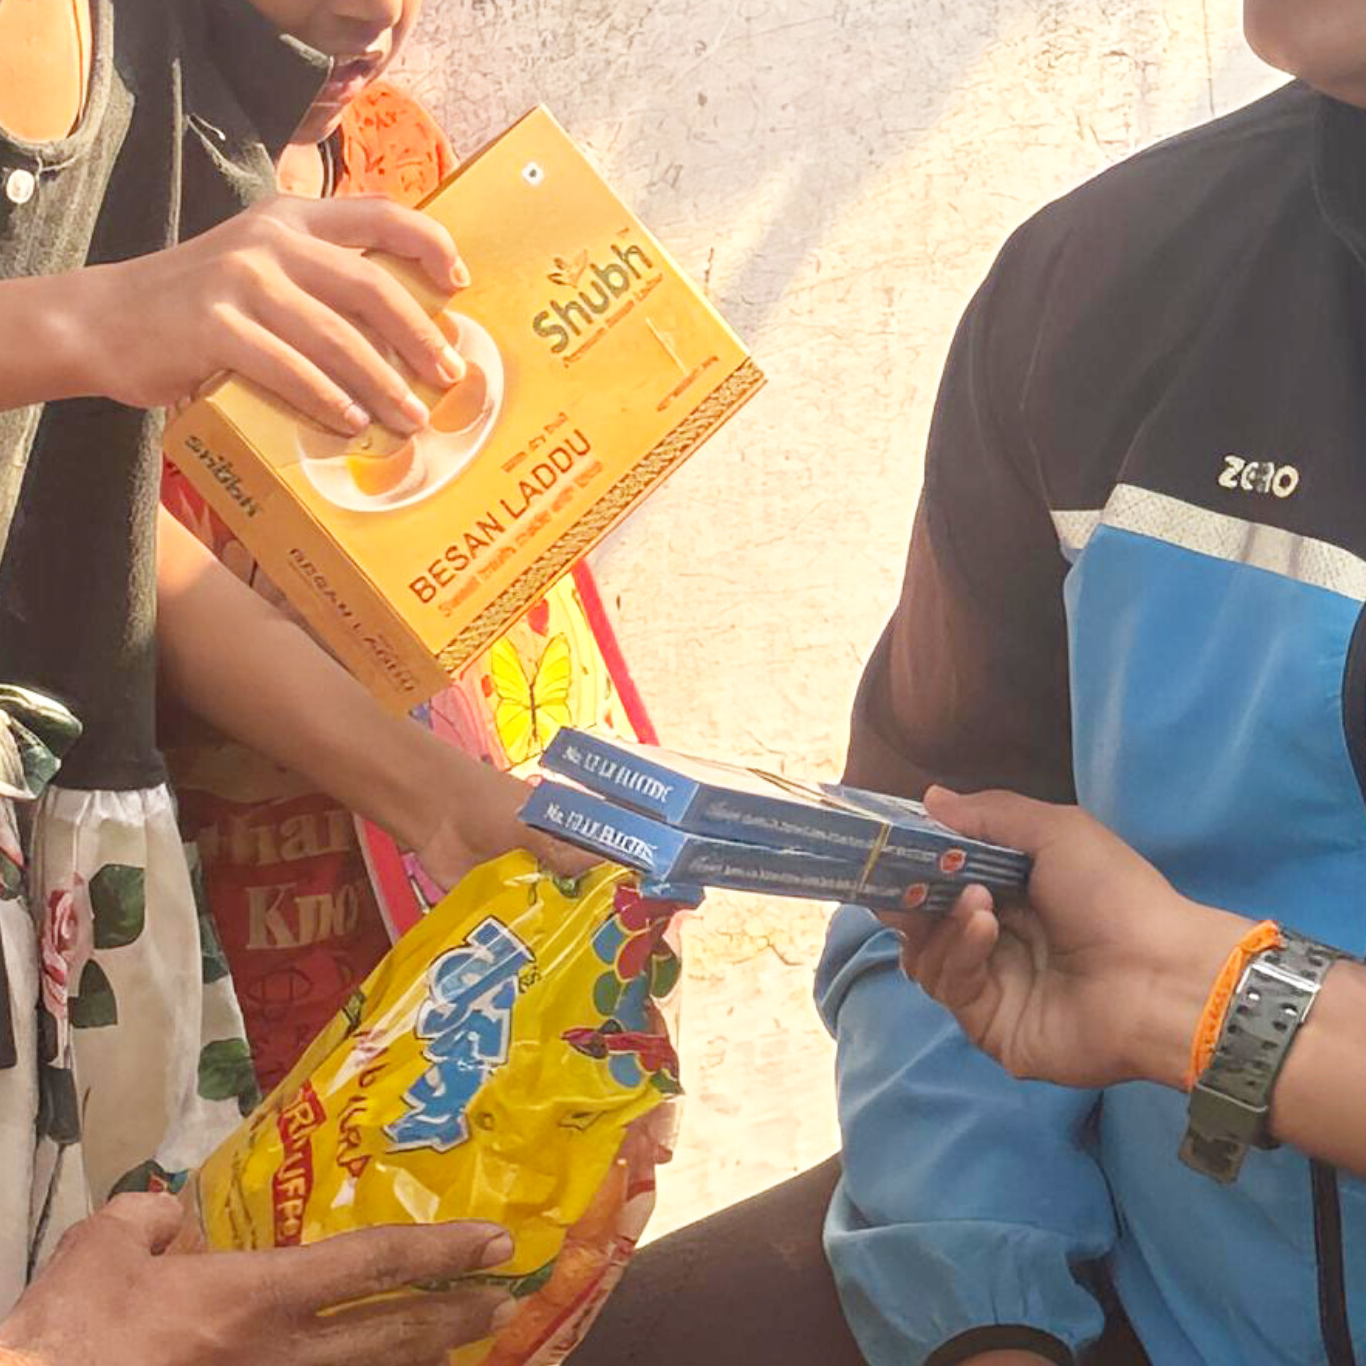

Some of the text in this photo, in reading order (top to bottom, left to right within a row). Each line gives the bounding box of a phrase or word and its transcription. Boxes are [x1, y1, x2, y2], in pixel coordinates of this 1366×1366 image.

[532, 244, 654, 354] Shubh
[407, 428, 592, 604] BESAN LADDU
